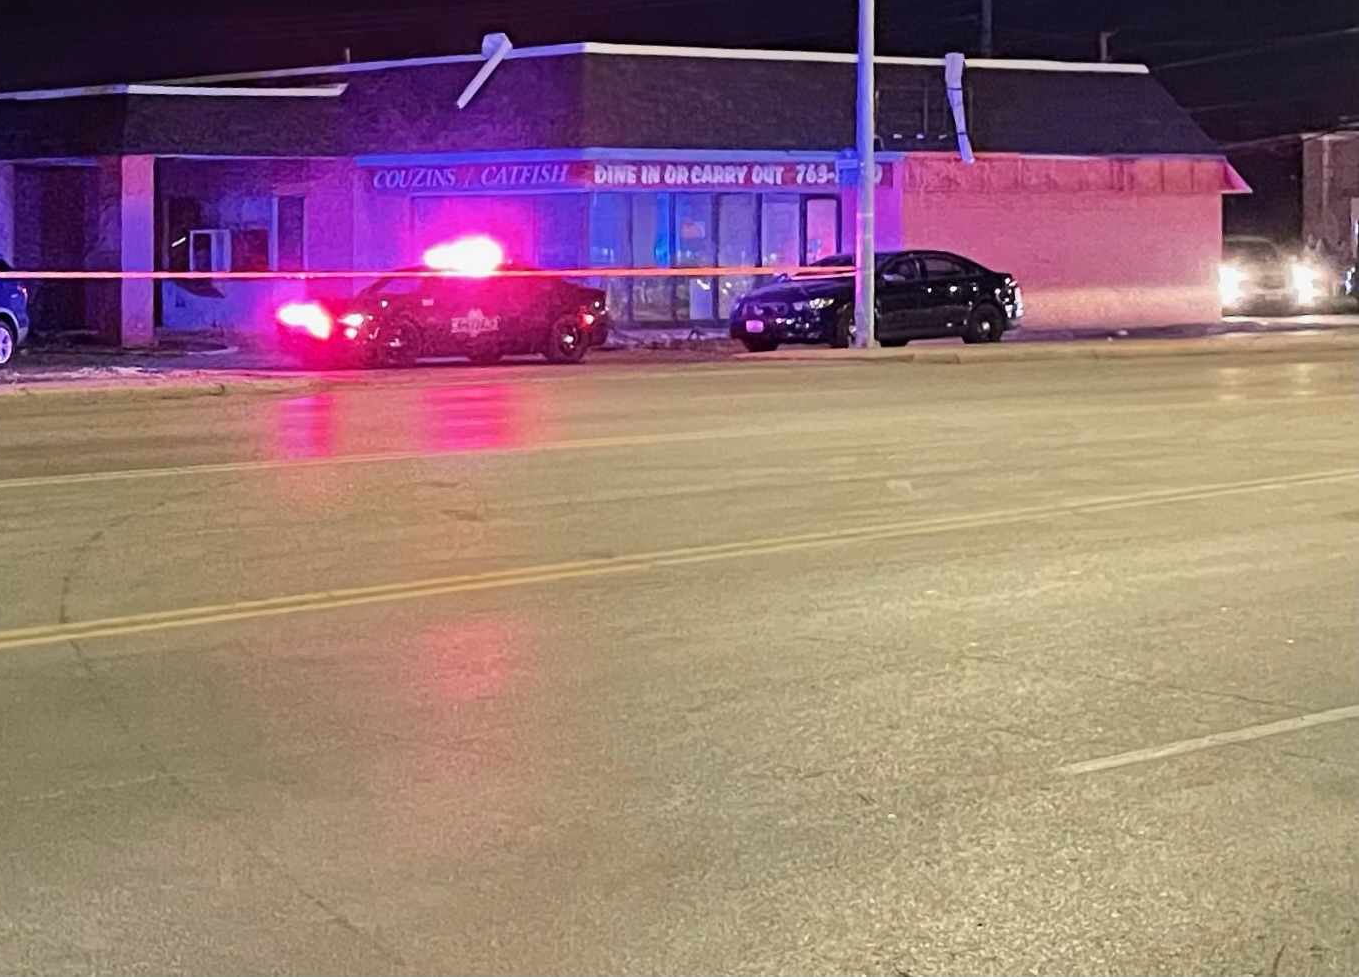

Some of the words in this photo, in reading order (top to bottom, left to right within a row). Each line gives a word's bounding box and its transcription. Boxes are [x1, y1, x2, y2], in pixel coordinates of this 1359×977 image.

[373, 167, 456, 188] COUZINS
[480, 165, 568, 186] CATFISH
[594, 164, 637, 184] DINE
[641, 164, 661, 185] IN
[664, 164, 689, 185] OR
[690, 164, 748, 184] CARRY
[751, 164, 784, 185] OUT
